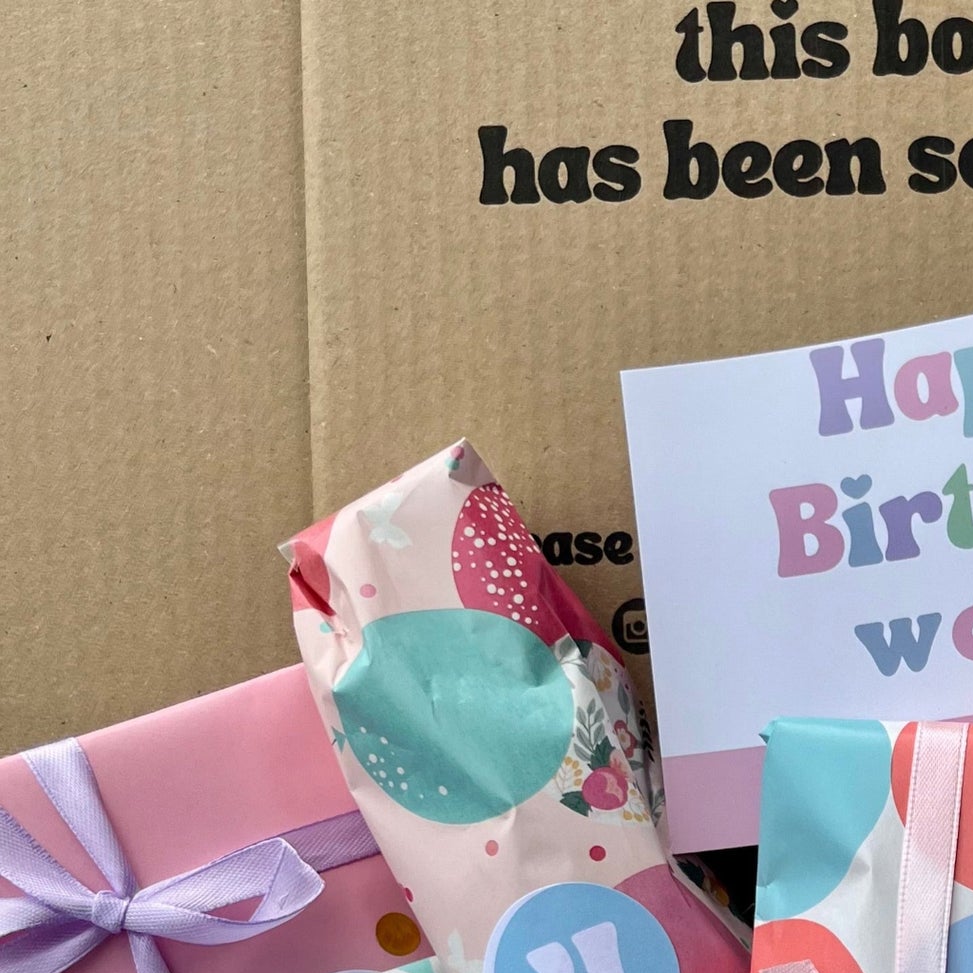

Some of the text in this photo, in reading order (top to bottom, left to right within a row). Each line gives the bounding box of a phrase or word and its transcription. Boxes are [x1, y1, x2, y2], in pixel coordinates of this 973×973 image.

[675, 0, 851, 83] this
[478, 125, 642, 204] has
[663, 119, 887, 199] been
[531, 531, 634, 565] ase
